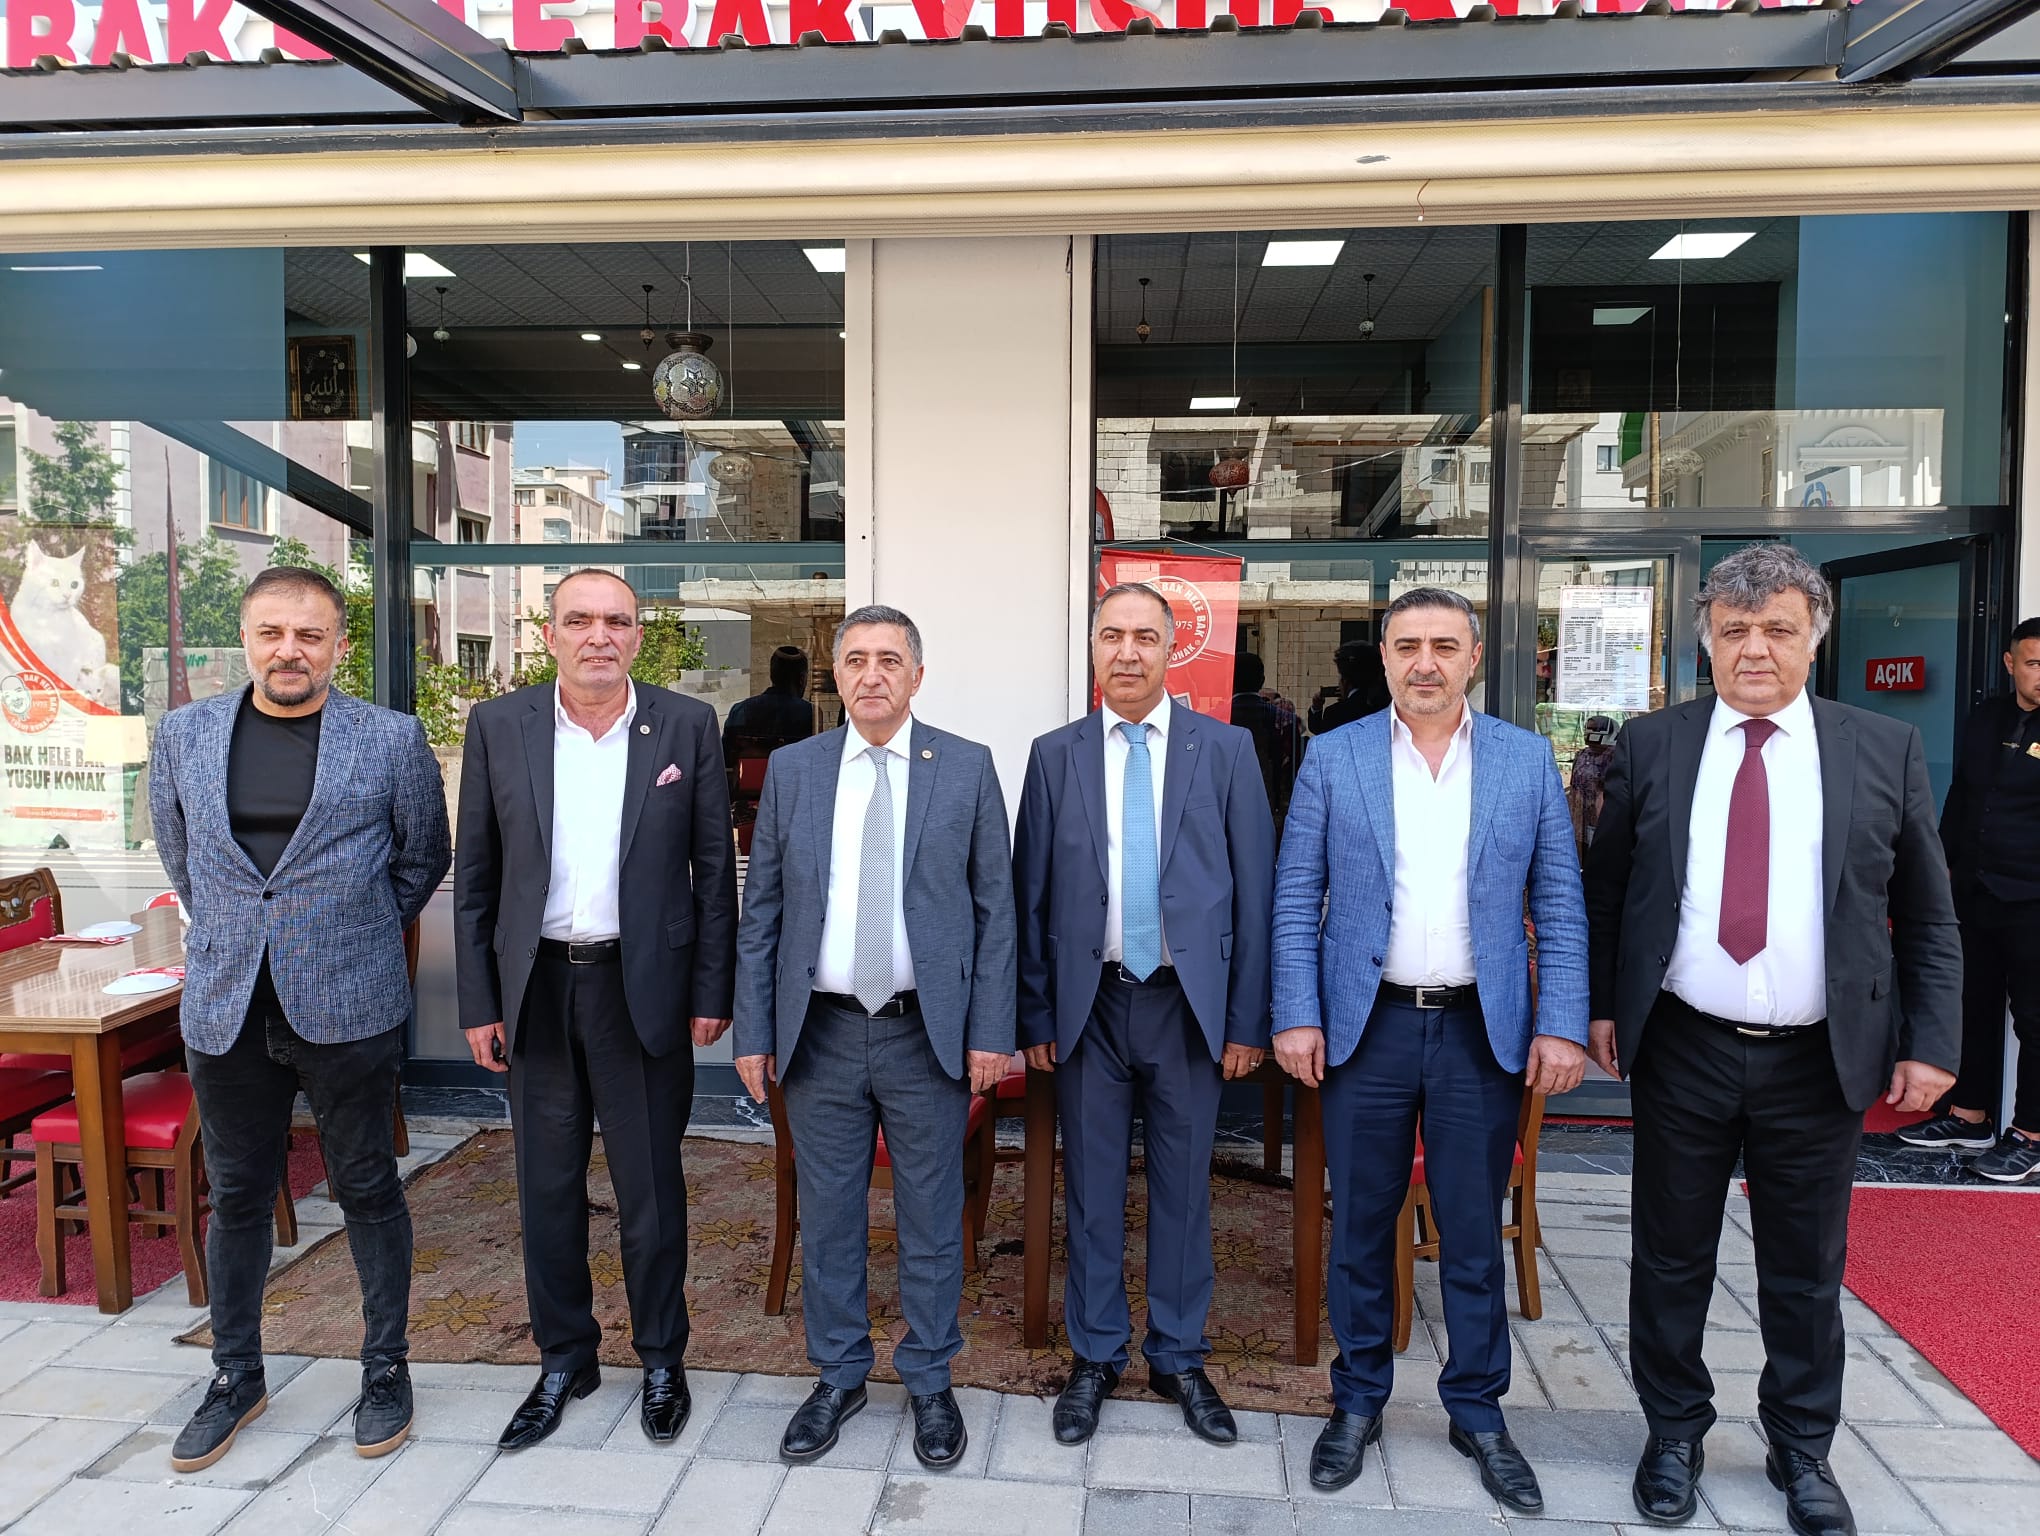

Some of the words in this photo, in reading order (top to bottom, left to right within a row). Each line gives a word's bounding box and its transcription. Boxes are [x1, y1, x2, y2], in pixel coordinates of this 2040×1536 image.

[1162, 582, 1183, 594] BAK
[1184, 590, 1203, 612] HELE
[1194, 615, 1206, 638] BAK
[1175, 620, 1193, 630] 975
[1172, 643, 1196, 661] ONAK
[1874, 662, 1914, 689] AÇIK
[4, 744, 34, 766] BAK
[37, 746, 72, 767] HELE
[5, 768, 51, 790] YUSUF
[54, 770, 107, 792] KONAK
